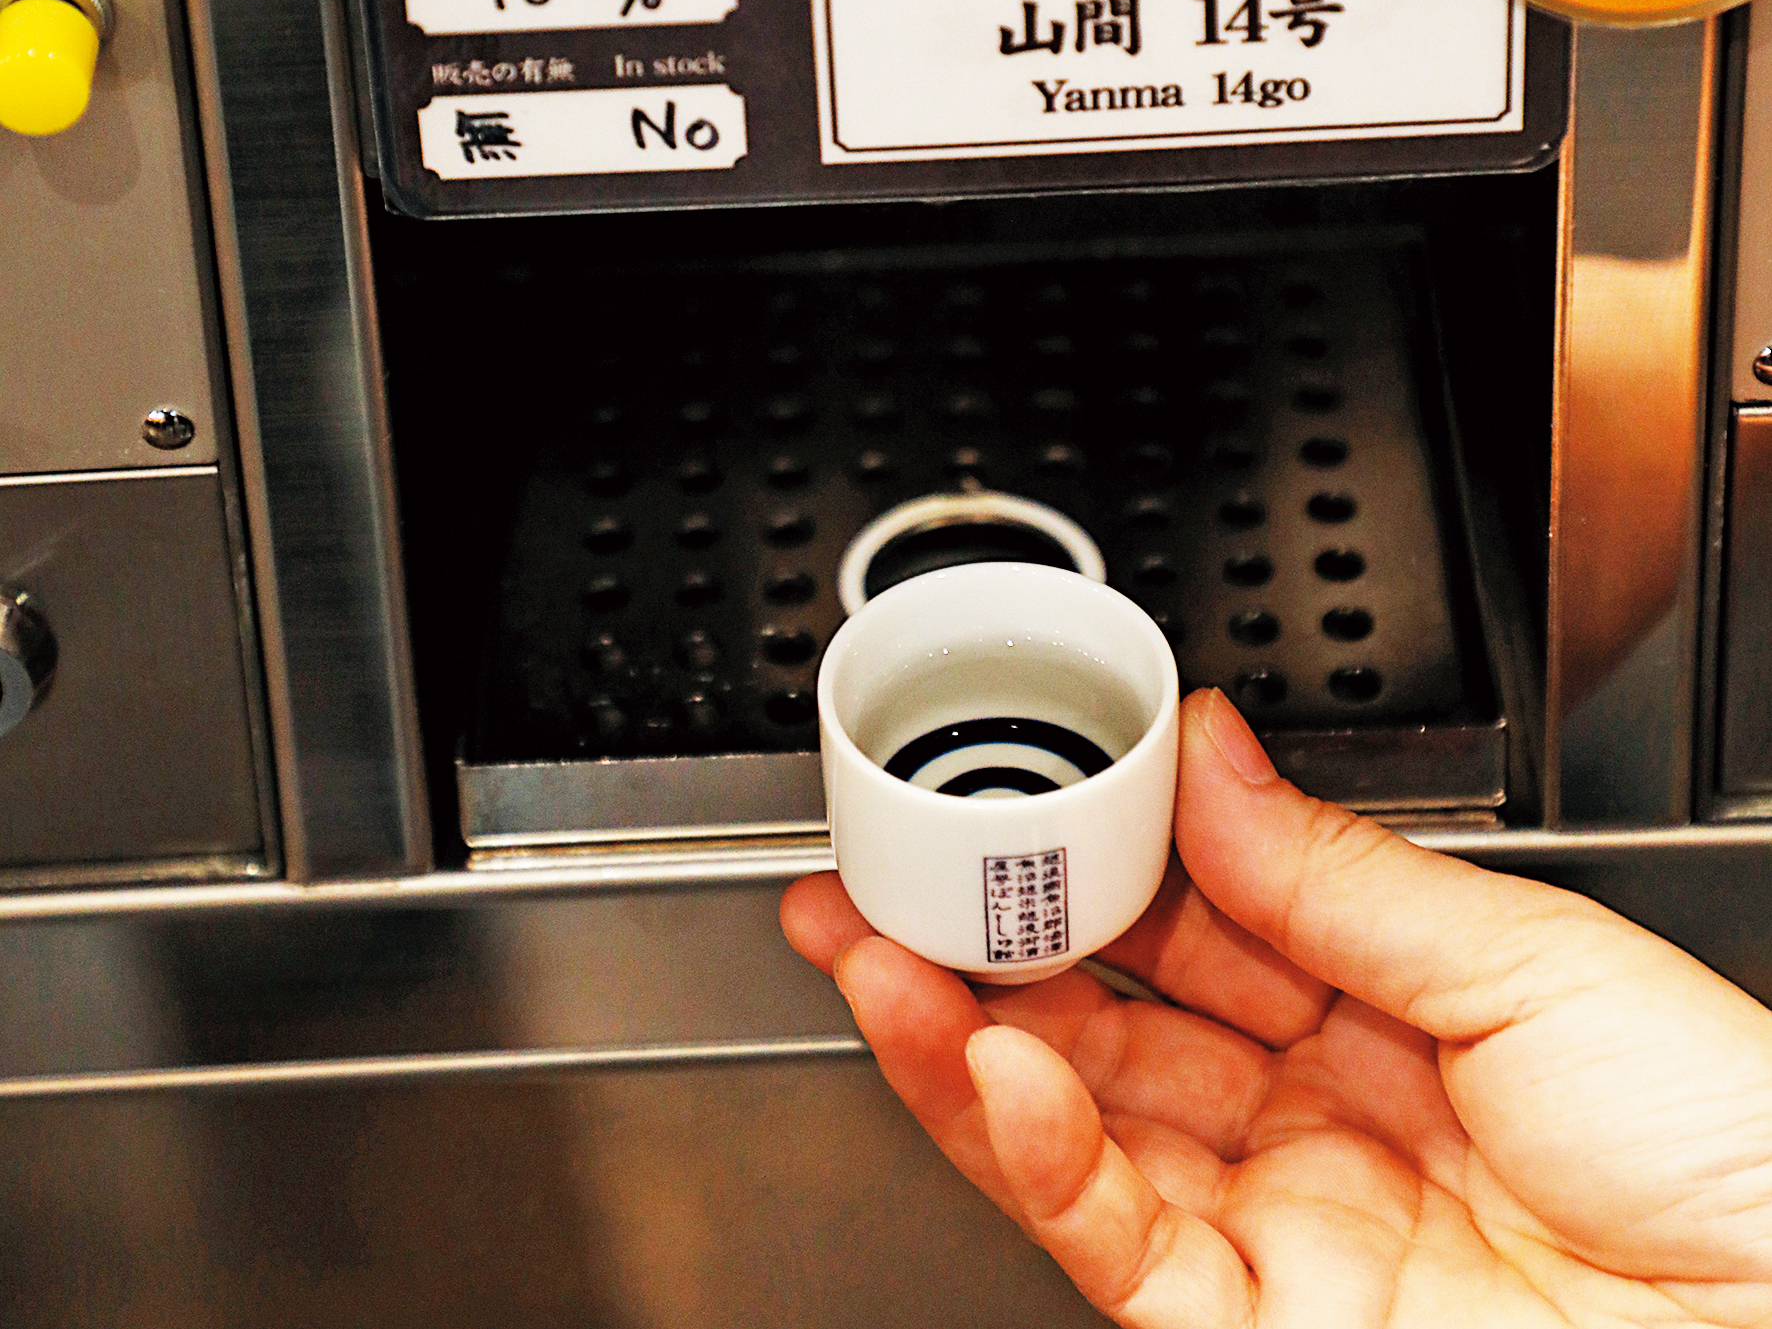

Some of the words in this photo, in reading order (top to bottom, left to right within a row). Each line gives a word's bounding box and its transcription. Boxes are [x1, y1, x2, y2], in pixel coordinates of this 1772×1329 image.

[431, 56, 576, 86] 販売の有無
[614, 53, 644, 79] In
[652, 50, 727, 77] stock
[1032, 76, 1186, 114] Yanma
[1211, 70, 1313, 109] 14go
[455, 108, 522, 164] 無
[631, 100, 720, 151] No
